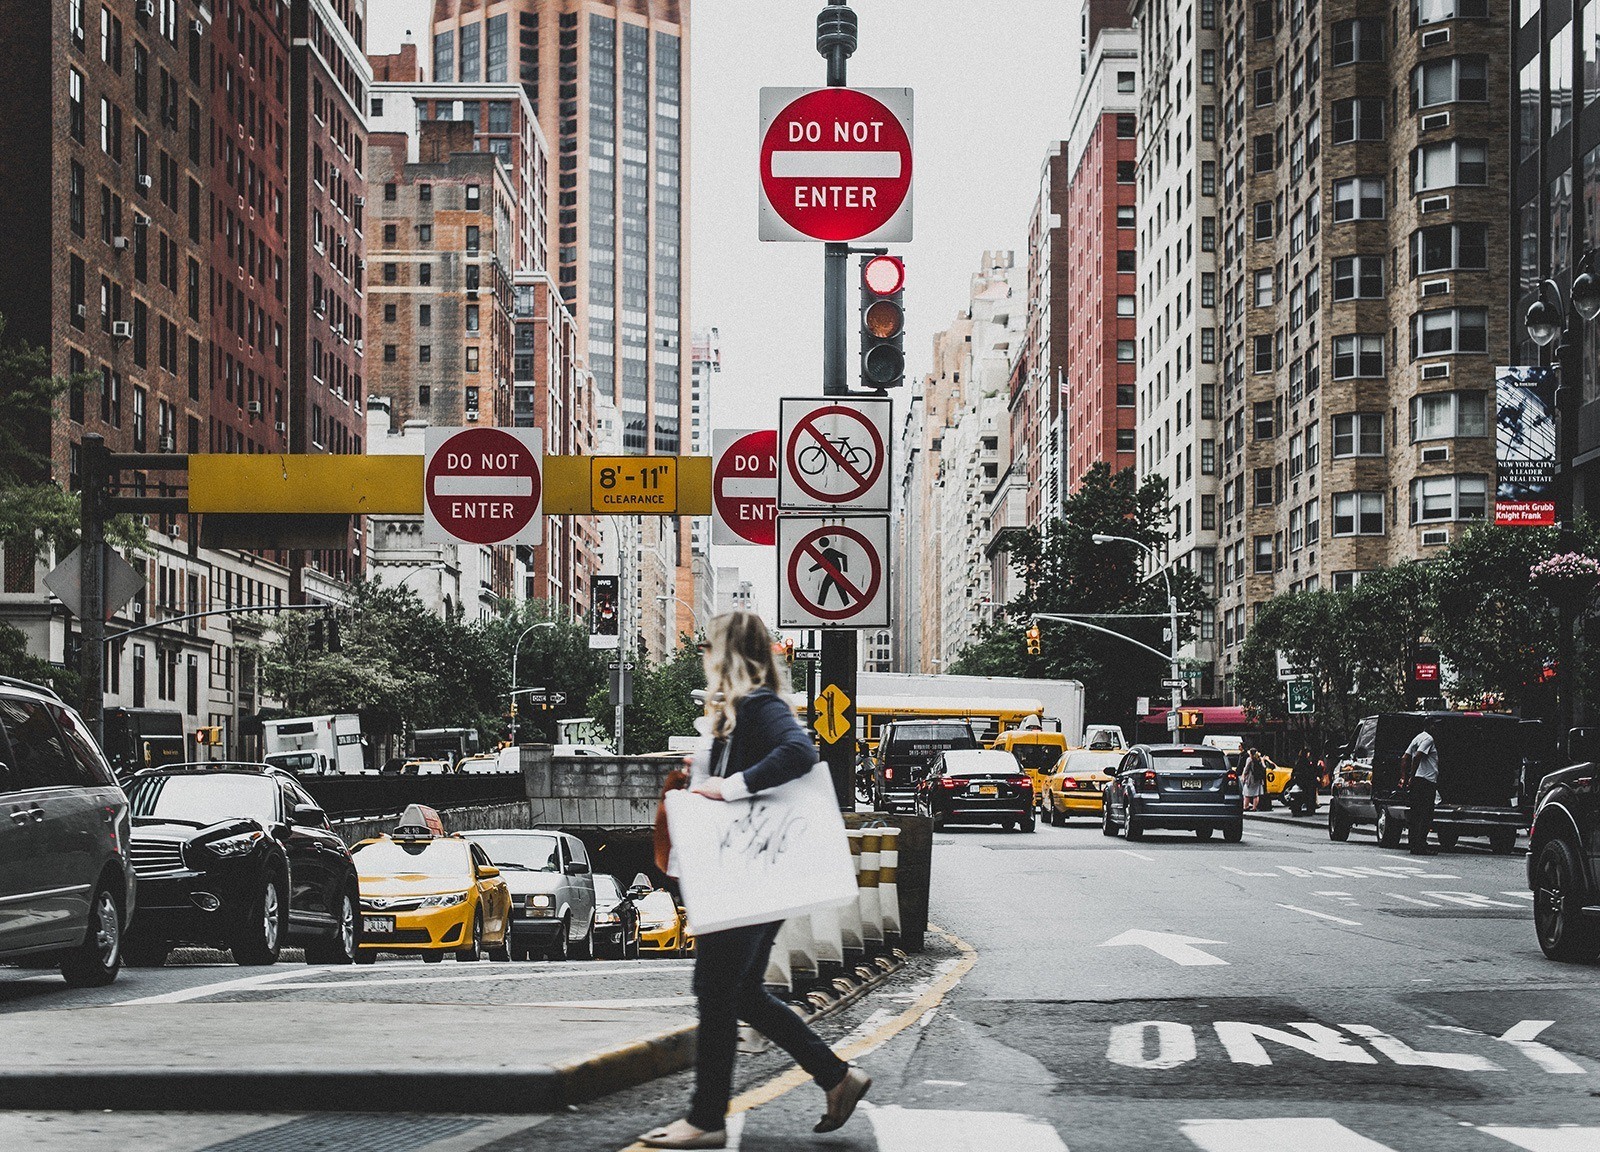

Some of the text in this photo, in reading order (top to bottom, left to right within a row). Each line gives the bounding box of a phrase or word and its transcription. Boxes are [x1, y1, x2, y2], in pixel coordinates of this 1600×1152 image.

[788, 121, 884, 143] DO NOT
[795, 186, 877, 208] ENTER
[447, 453, 519, 470] DO NOT
[735, 455, 760, 471] DO
[603, 494, 665, 504] CLEARANCE
[1496, 503, 1555, 511] Newmark Grubb
[452, 502, 514, 519] ENTER
[739, 504, 776, 520] ENT
[1496, 511, 1542, 521] Knight Frank
[1105, 1019, 1588, 1074] ONLY
